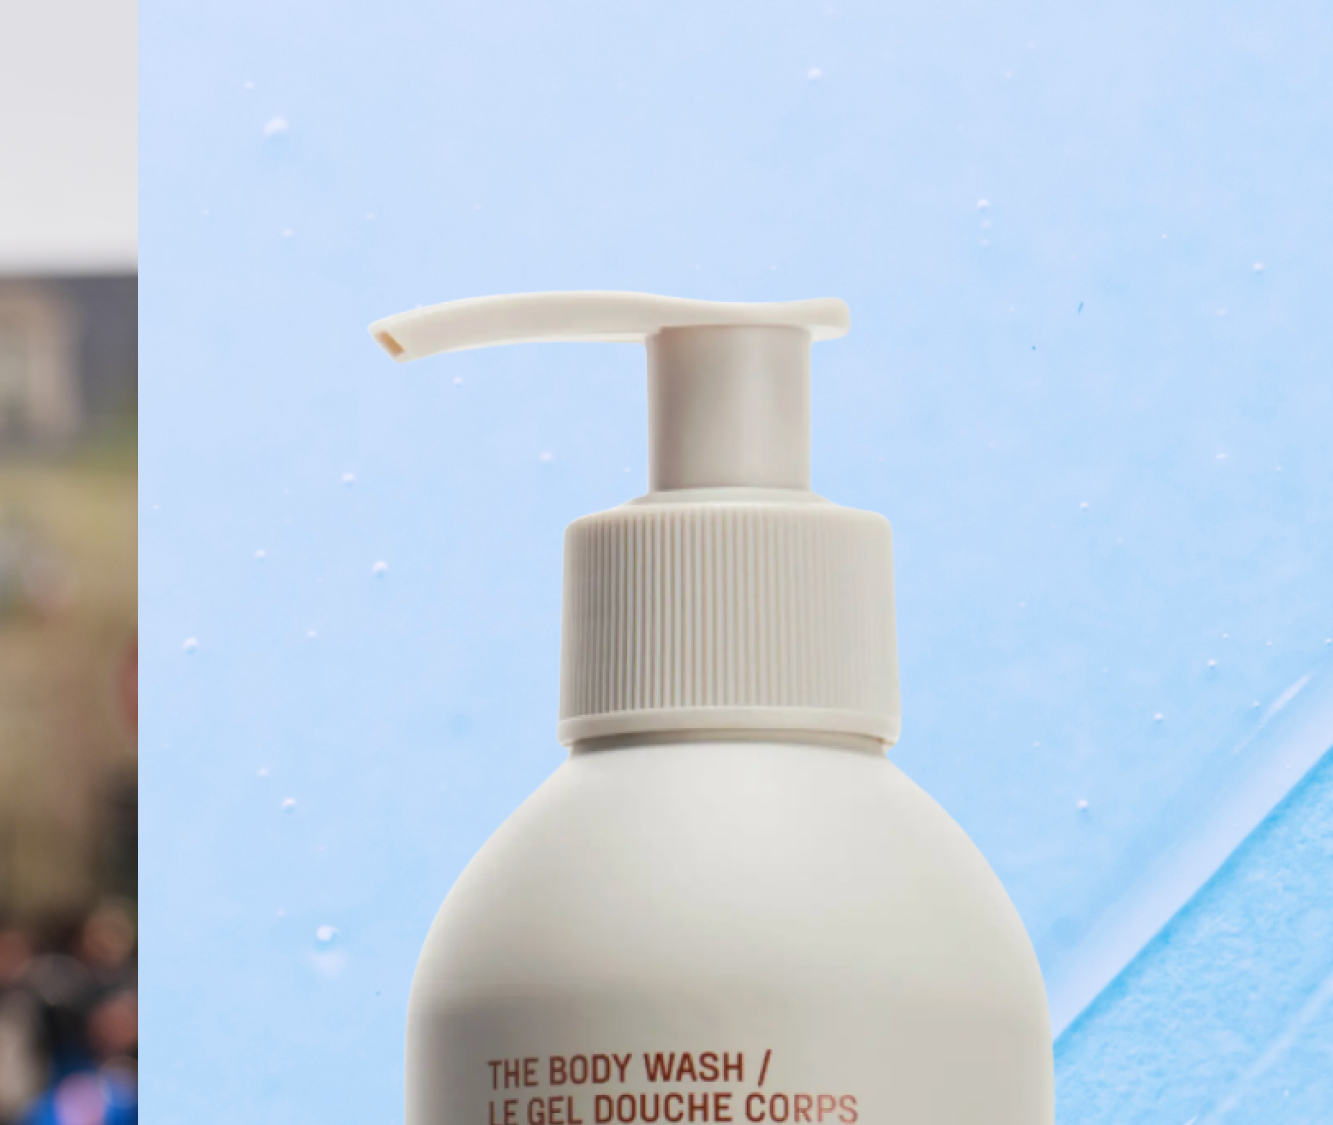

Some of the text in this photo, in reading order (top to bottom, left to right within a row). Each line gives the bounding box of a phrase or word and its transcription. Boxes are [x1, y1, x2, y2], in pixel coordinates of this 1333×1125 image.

[488, 1058, 539, 1090] THE
[549, 1053, 633, 1086] BODY
[643, 1052, 745, 1084] WASH
[594, 1092, 733, 1125] DOUCHE
[745, 1092, 859, 1124] CORPS
